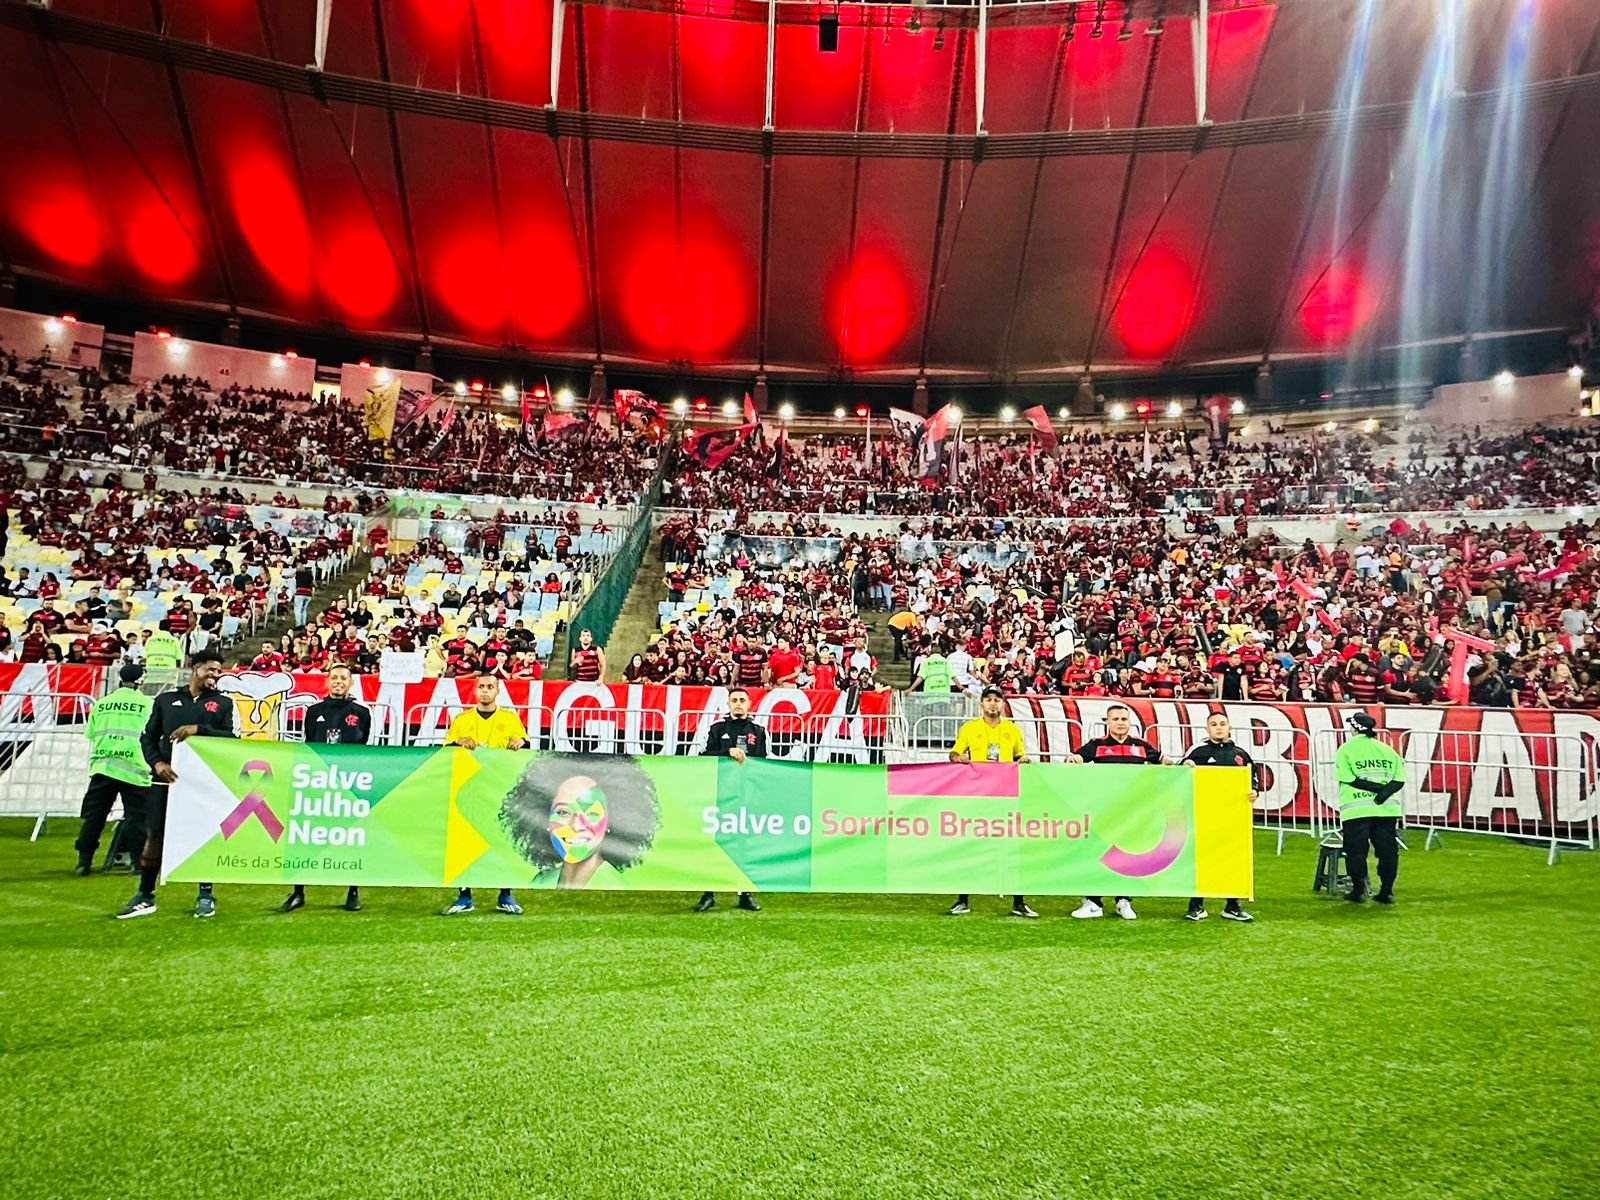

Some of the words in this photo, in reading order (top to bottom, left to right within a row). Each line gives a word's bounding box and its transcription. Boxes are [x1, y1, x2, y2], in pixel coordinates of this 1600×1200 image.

[98, 702, 146, 713] SUNSET
[292, 763, 373, 790] Salve
[1355, 759, 1393, 769] SUNSET
[289, 791, 370, 818] Julho
[288, 819, 365, 846] Neon
[702, 806, 784, 836] Salve
[793, 815, 812, 836] o
[821, 809, 929, 837] Sorriso
[939, 811, 1090, 840] Brasileiro!
[216, 855, 248, 868] Mês
[251, 856, 270, 868] da
[273, 856, 319, 870] Saúde
[323, 858, 363, 871] Bucal
